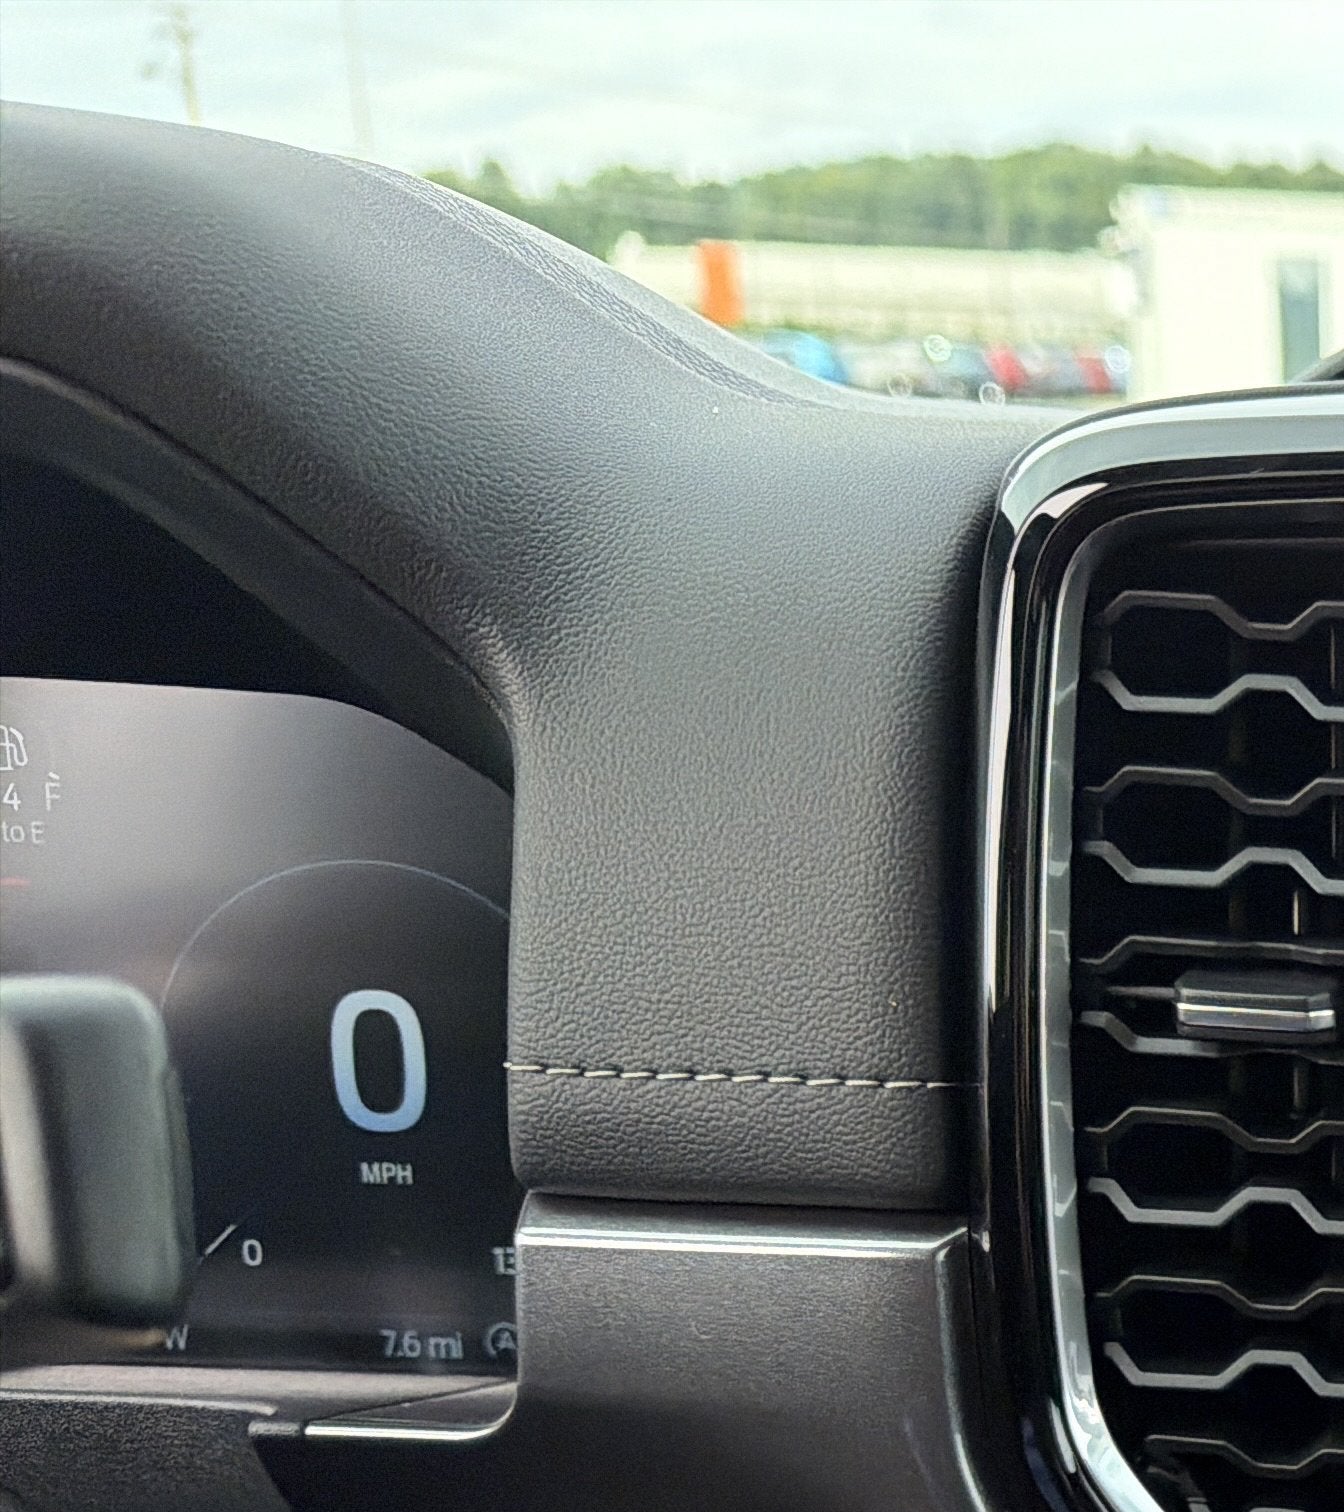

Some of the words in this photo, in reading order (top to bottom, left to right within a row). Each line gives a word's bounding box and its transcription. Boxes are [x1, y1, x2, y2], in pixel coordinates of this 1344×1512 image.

[331, 990, 428, 1134] 0
[360, 1161, 414, 1187] MPH
[241, 1238, 264, 1267] 0
[427, 1330, 464, 1360] mi
